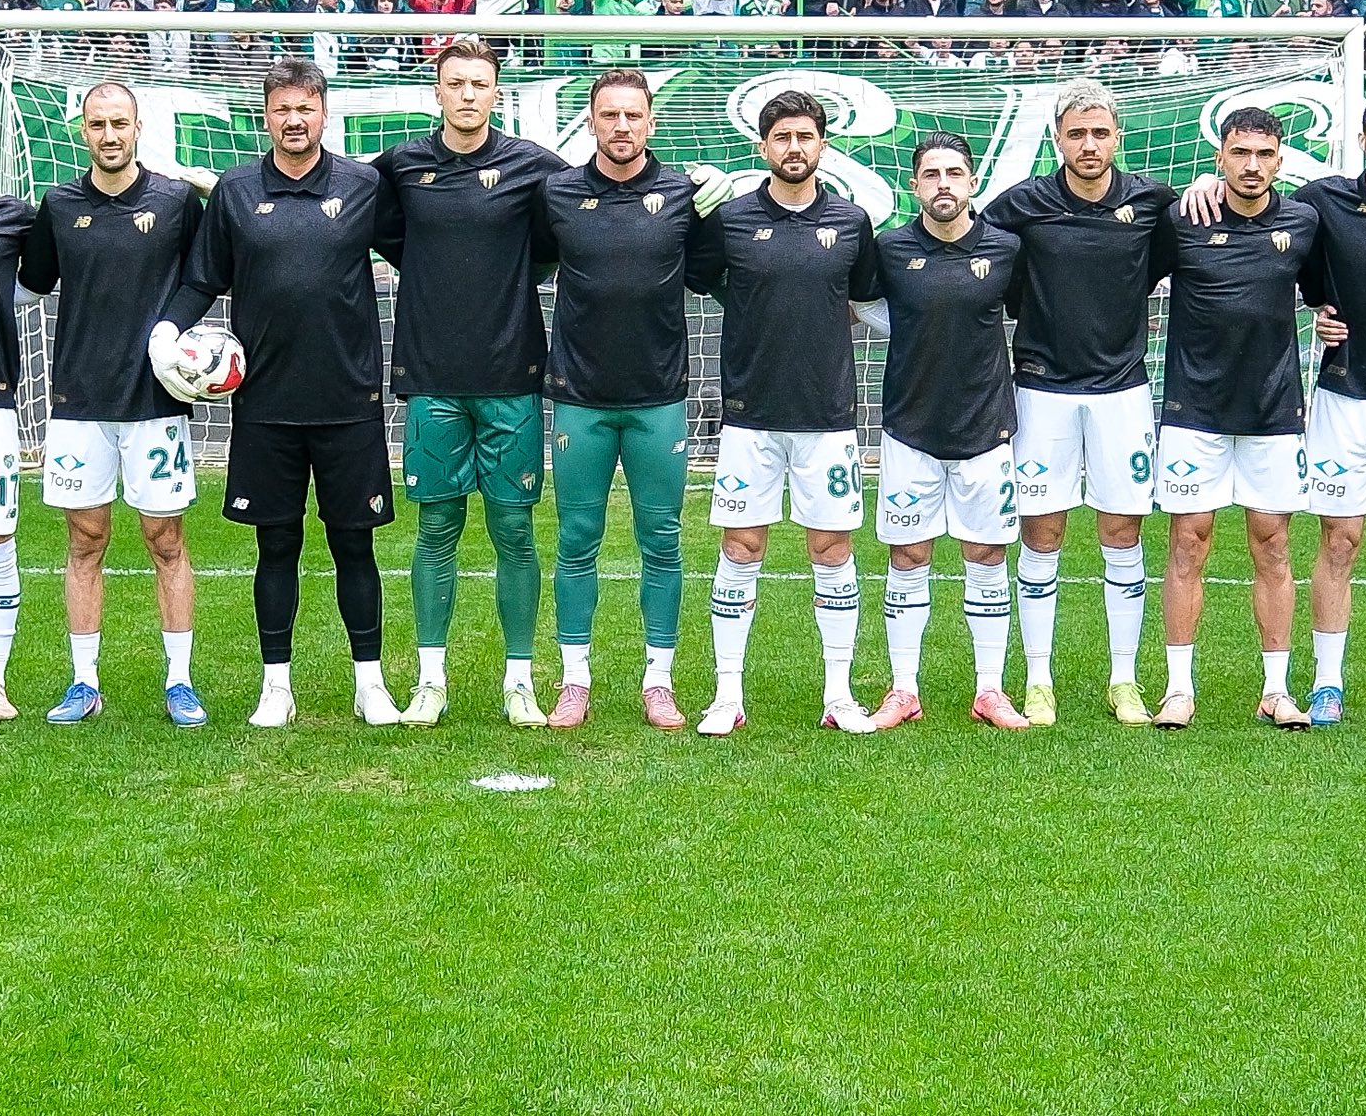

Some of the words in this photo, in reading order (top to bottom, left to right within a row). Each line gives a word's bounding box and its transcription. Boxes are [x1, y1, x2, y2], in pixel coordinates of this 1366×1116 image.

[149, 442, 187, 479] 24
[1129, 446, 1158, 484] 9
[50, 471, 82, 490] Togg
[827, 462, 861, 499] 80
[1017, 481, 1047, 496] Togg
[1164, 480, 1199, 495] Togg
[1310, 480, 1346, 497] Togg
[713, 495, 747, 513] Togg
[1000, 482, 1013, 513] 2
[885, 511, 920, 526] Togg
